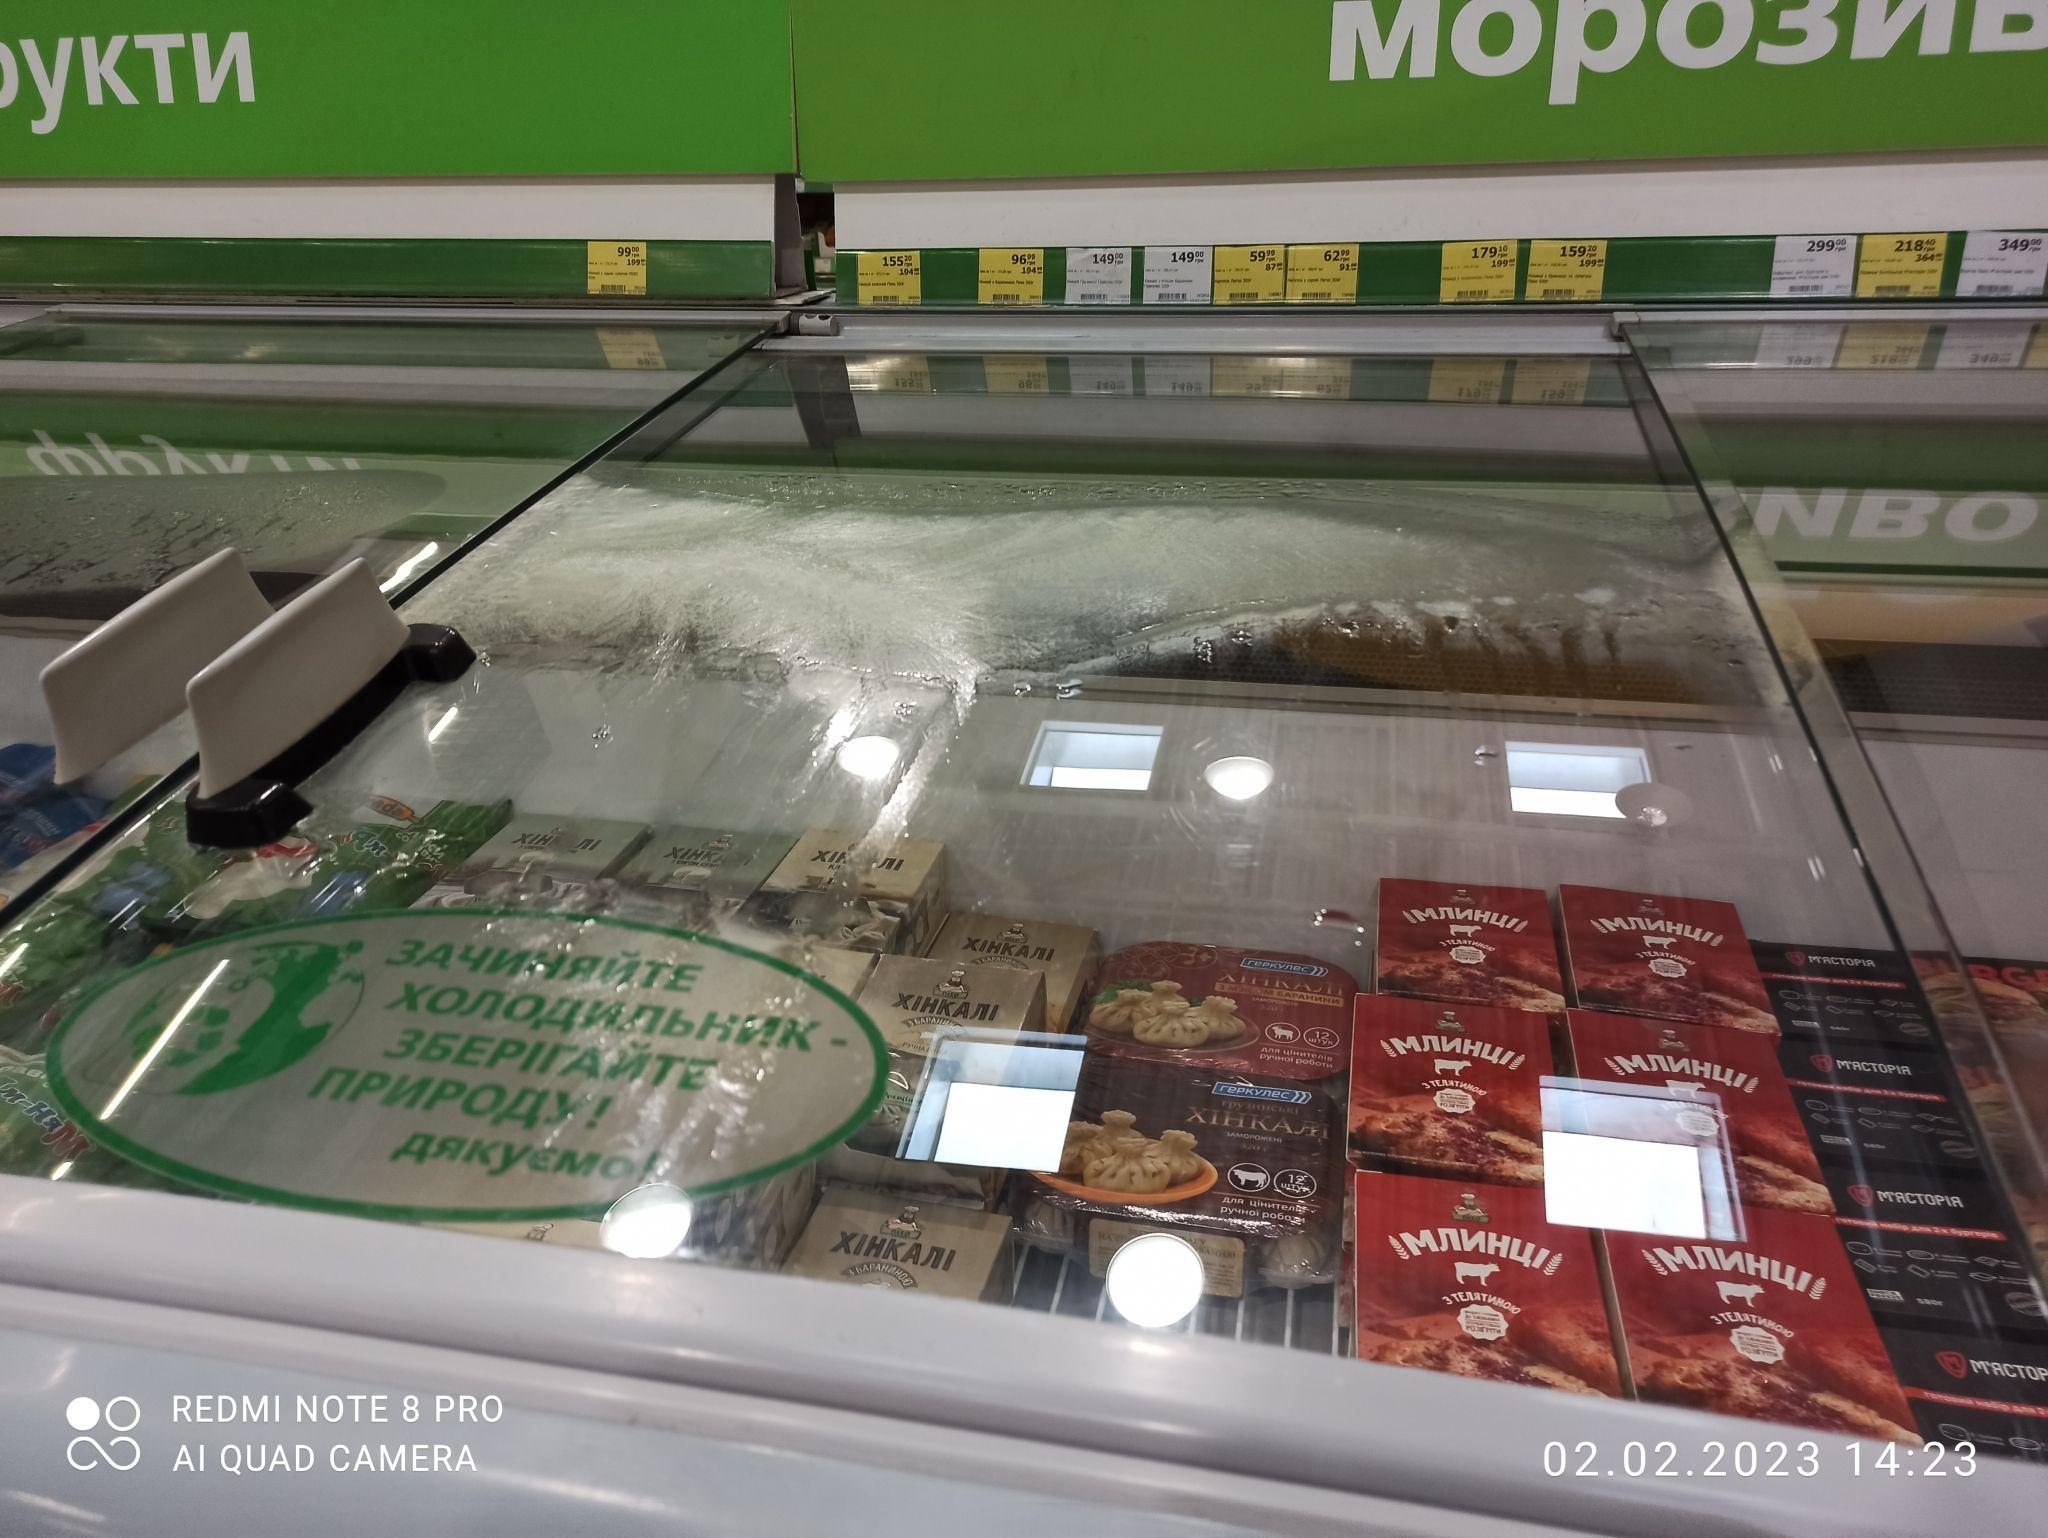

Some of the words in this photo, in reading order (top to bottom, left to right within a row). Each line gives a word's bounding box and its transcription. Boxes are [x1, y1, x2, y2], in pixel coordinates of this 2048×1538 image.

[617, 246, 631, 257] 99
[1472, 247, 1497, 258] 179
[1560, 246, 1586, 258] 159
[1806, 240, 1835, 252] 299
[1894, 240, 1924, 252] 218
[1998, 238, 2030, 251] 349
[882, 256, 904, 266] 155
[1011, 254, 1026, 264] 96
[1092, 254, 1114, 264] 149
[1171, 252, 1194, 263] 149
[1250, 250, 1266, 262] 59
[1324, 250, 1340, 261] 62
[1413, 906, 1521, 930] МЛИНЦІ
[1603, 917, 1713, 945] МЛИНЦІ
[962, 937, 1055, 962] ХІНКАЛІ
[385, 937, 704, 995] ЗАЧИНЯЙТЕ
[1244, 960, 1310, 975] геркулес
[1808, 955, 1876, 968] М'ЯСТОРІЯ
[891, 992, 1000, 1021] ХІНКАЛІ
[388, 981, 822, 1053] ХОЛОДИЛЬНИК
[1314, 1031, 1330, 1040] 12
[1261, 1047, 1279, 1056] для
[1282, 1048, 1333, 1063] цінителів
[1392, 1035, 1516, 1066] МЛИНЦІ
[382, 1027, 722, 1093] ЗБЕРІГАЙТЕ
[1259, 1054, 1295, 1064] ручної
[1295, 1058, 1333, 1070] роботи
[1836, 1059, 1912, 1076] М'ЯСТОРІЯ
[1618, 1053, 1748, 1090] МЛИНЦІ
[1218, 1085, 1289, 1101] геркулес
[1432, 1080, 1488, 1097] ТЕЛЯТИНОЮ
[308, 1066, 612, 1133] ПРИРОДУ!
[1185, 1106, 1329, 1140] ХІНКАЛІ
[1222, 1196, 1245, 1206] для
[1876, 1190, 1964, 1209] М'ЯСТОРІЯ
[1220, 1205, 1260, 1218] ручної
[830, 1231, 956, 1271] ХІНКАЛІ
[1398, 1228, 1549, 1270] МЛИНЦІ
[855, 1263, 916, 1287] БАРАНИНОЮ
[1653, 1244, 1812, 1294] МЛИНЦІ
[1453, 1292, 1522, 1315] ТЕЛЯТИНОЮ
[1724, 1312, 1795, 1338] ТЕЛЯТИНОЮ
